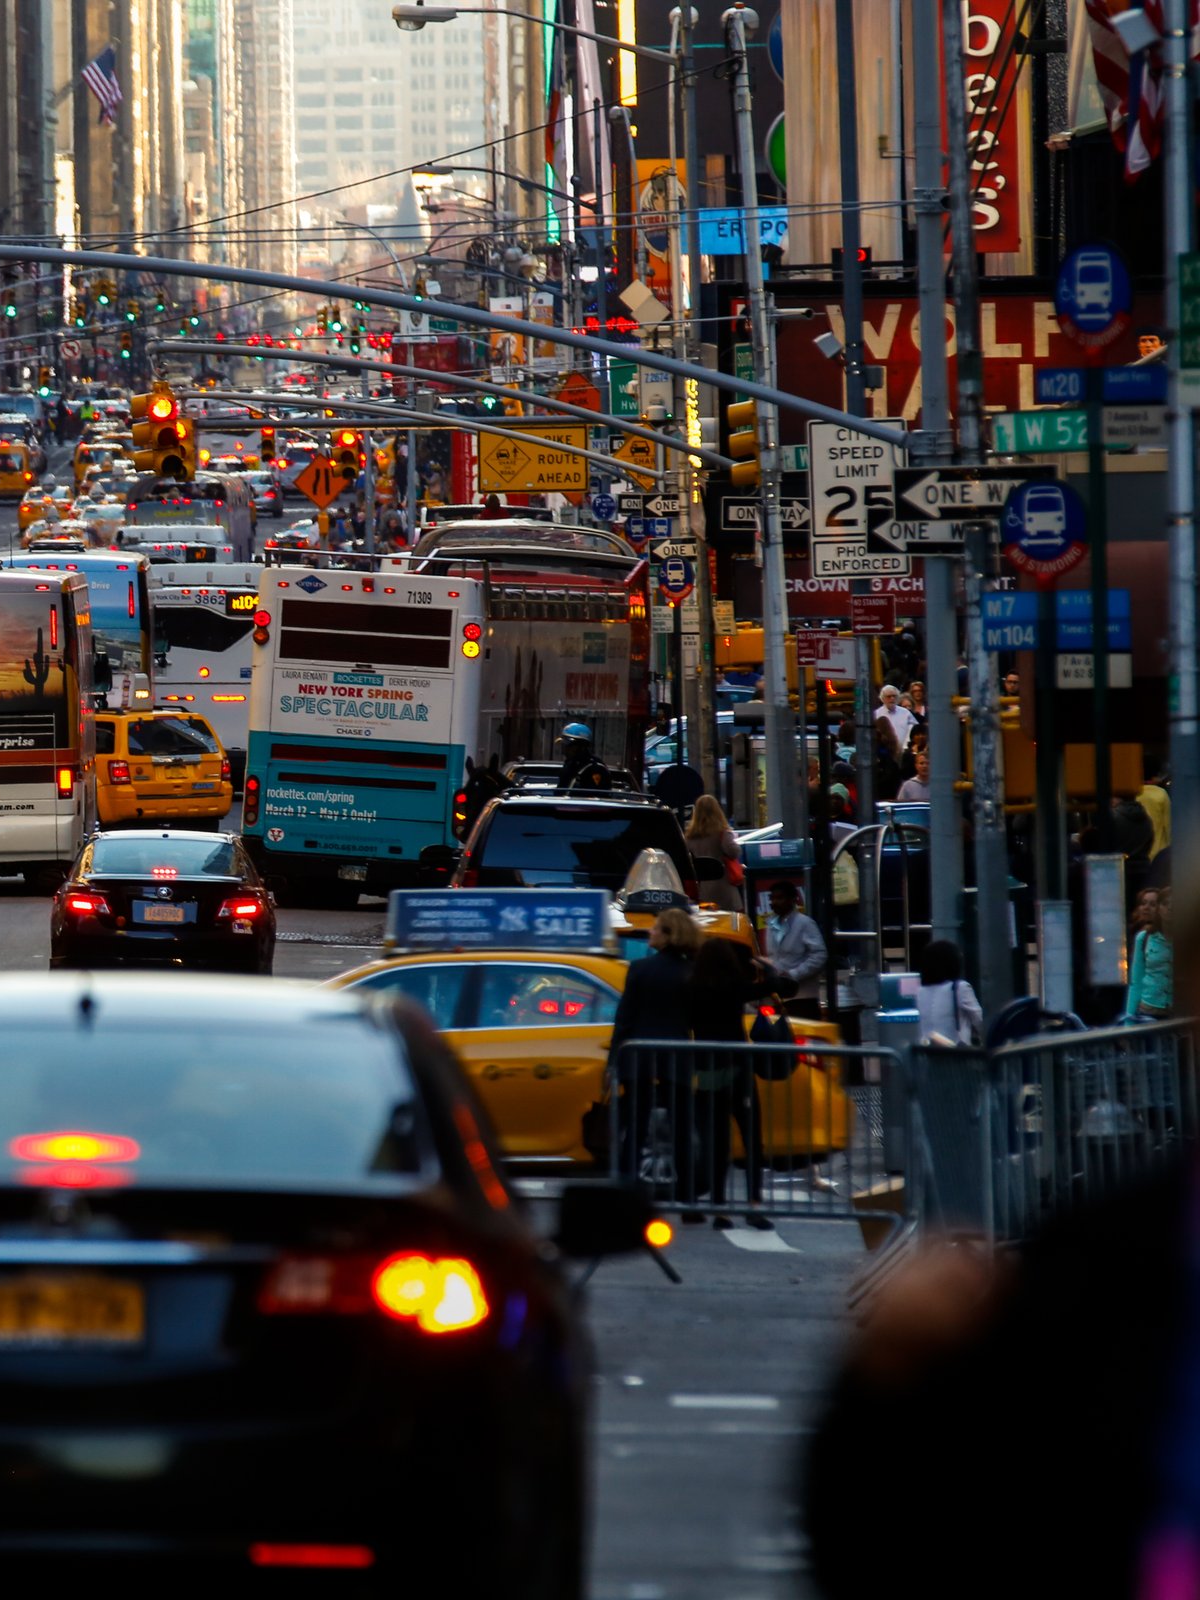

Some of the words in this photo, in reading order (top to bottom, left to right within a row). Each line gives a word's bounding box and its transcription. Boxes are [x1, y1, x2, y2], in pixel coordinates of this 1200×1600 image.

[1041, 372, 1080, 397] M20
[1023, 418, 1045, 447] W
[537, 454, 580, 466] ROUTE
[828, 446, 884, 460] SPEED
[834, 463, 880, 479] LIMIT
[536, 473, 582, 484] AHEAD
[924, 484, 973, 505] ONE
[656, 498, 678, 511] ONE
[737, 508, 756, 520] ON
[888, 522, 930, 540] ONE
[663, 546, 686, 556] ONE
[836, 545, 866, 558] PHO
[821, 558, 901, 572] ENFORCED
[1025, 546, 1082, 573] STANDING
[91, 581, 111, 590] Drive
[194, 593, 226, 606] 3862
[407, 590, 433, 605] 71309
[864, 598, 888, 606] STANDING
[986, 624, 1036, 647] M104
[282, 670, 301, 679] LAURA
[302, 671, 328, 681] BENANTI
[337, 674, 382, 685] ROCKETTES
[389, 677, 408, 687] DEREK
[409, 678, 431, 688] HOUGH
[298, 683, 328, 695] NEW
[330, 685, 364, 698] YORK
[367, 689, 414, 701] SPRING
[280, 695, 429, 722] SPECTACULAR
[336, 727, 363, 736] CHASE
[266, 787, 355, 805] rockettes.com/spring
[265, 803, 294, 817] March
[297, 805, 307, 818] 12
[319, 807, 338, 822] May
[350, 809, 377, 824] Only!
[534, 918, 593, 936] SALE
